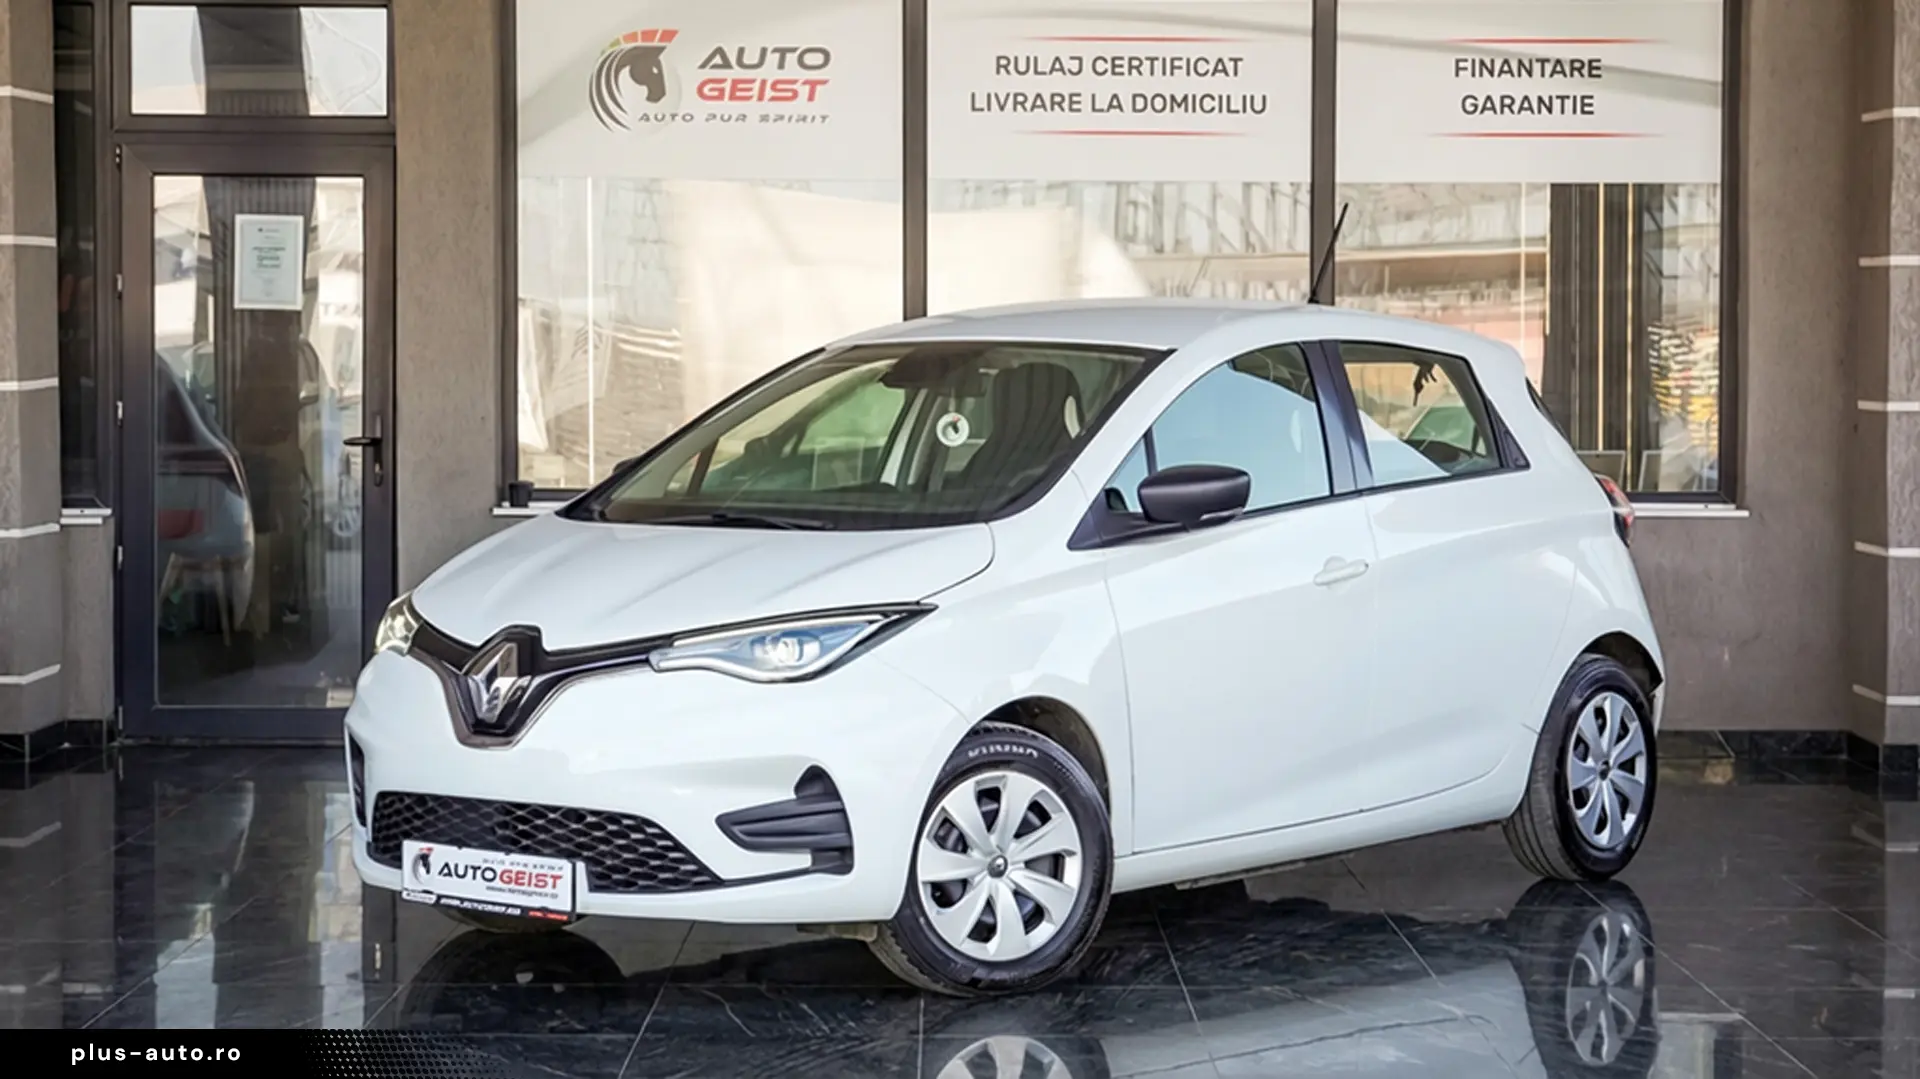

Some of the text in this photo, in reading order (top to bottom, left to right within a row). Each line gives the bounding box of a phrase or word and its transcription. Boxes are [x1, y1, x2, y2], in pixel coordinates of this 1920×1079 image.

[697, 46, 831, 71] AUTO
[995, 55, 1244, 77] RULAJ CERTIFICAT
[1454, 58, 1602, 78] FINANTARE
[696, 78, 830, 102] GEIST
[970, 92, 1268, 114] LIVRARE LA DOMICILIU
[1461, 94, 1595, 115] GARANTIE
[638, 112, 694, 123] AUTO
